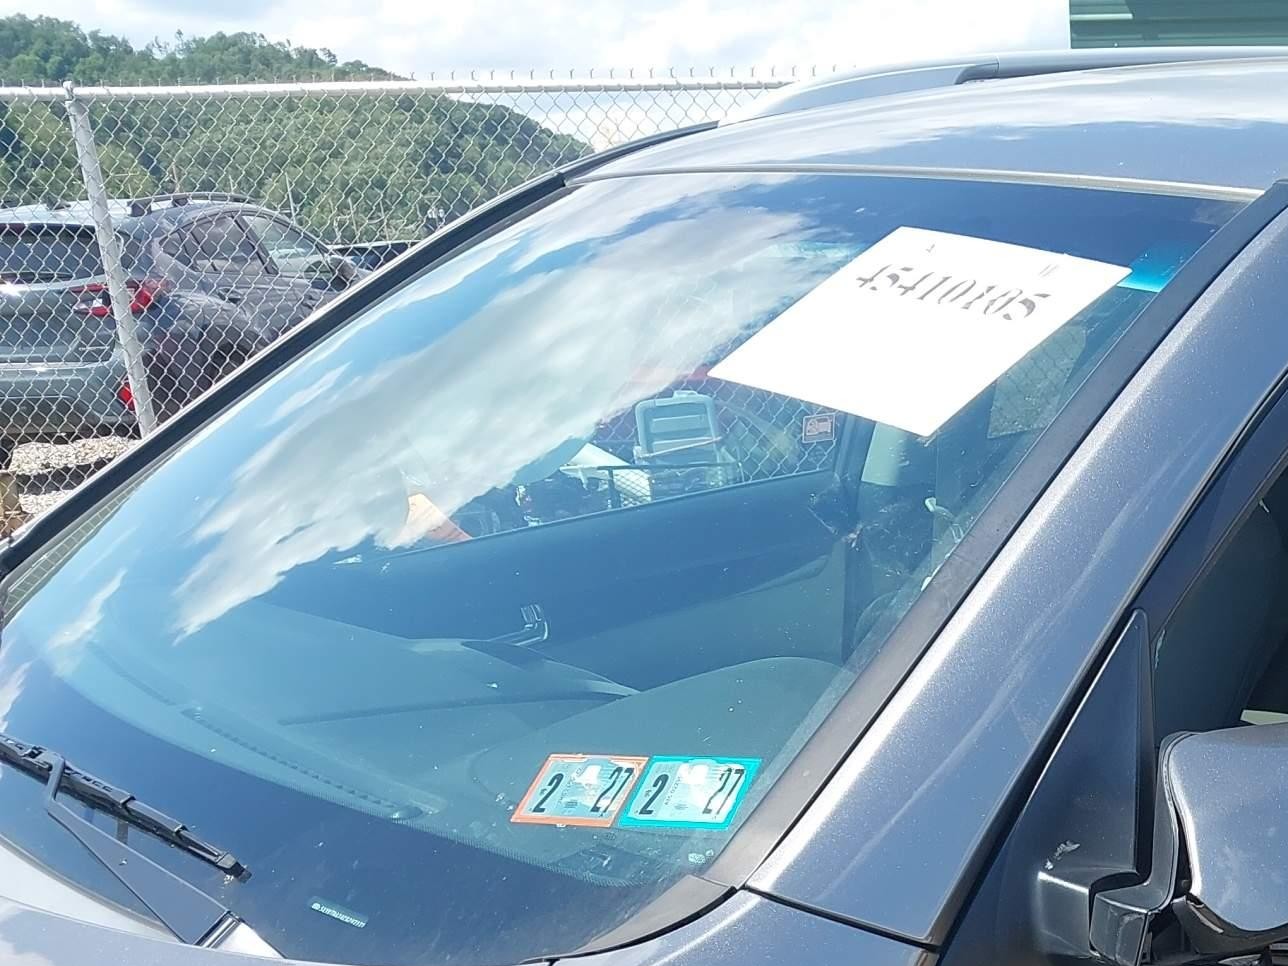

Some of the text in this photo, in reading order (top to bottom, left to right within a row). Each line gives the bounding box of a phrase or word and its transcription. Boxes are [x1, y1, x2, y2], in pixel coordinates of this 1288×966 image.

[856, 264, 1051, 321] 45410105
[532, 773, 564, 813] 2
[590, 766, 634, 814] 27
[639, 774, 669, 815] 2
[702, 768, 745, 815] 27
